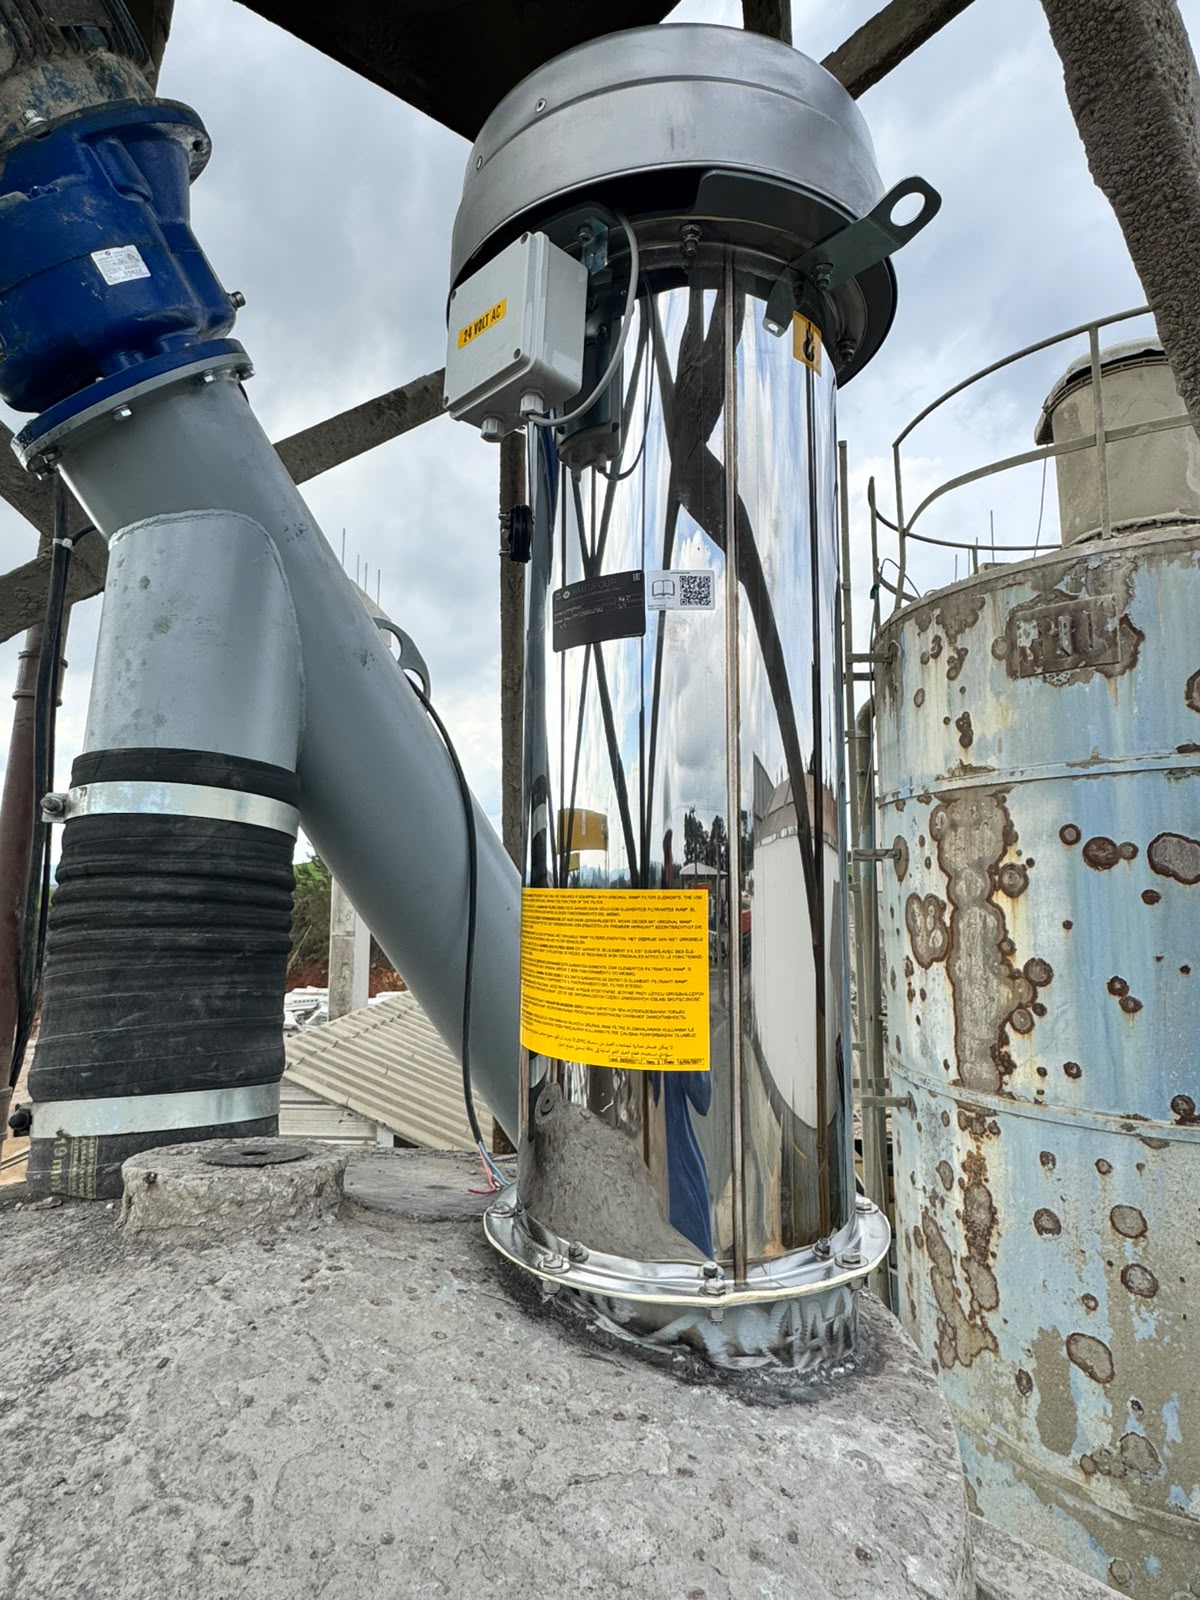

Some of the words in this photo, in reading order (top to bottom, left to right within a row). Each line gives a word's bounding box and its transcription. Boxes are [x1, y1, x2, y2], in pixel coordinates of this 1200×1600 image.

[463, 326, 472, 343] 24
[474, 313, 490, 335] VOLT
[491, 304, 501, 322] AC
